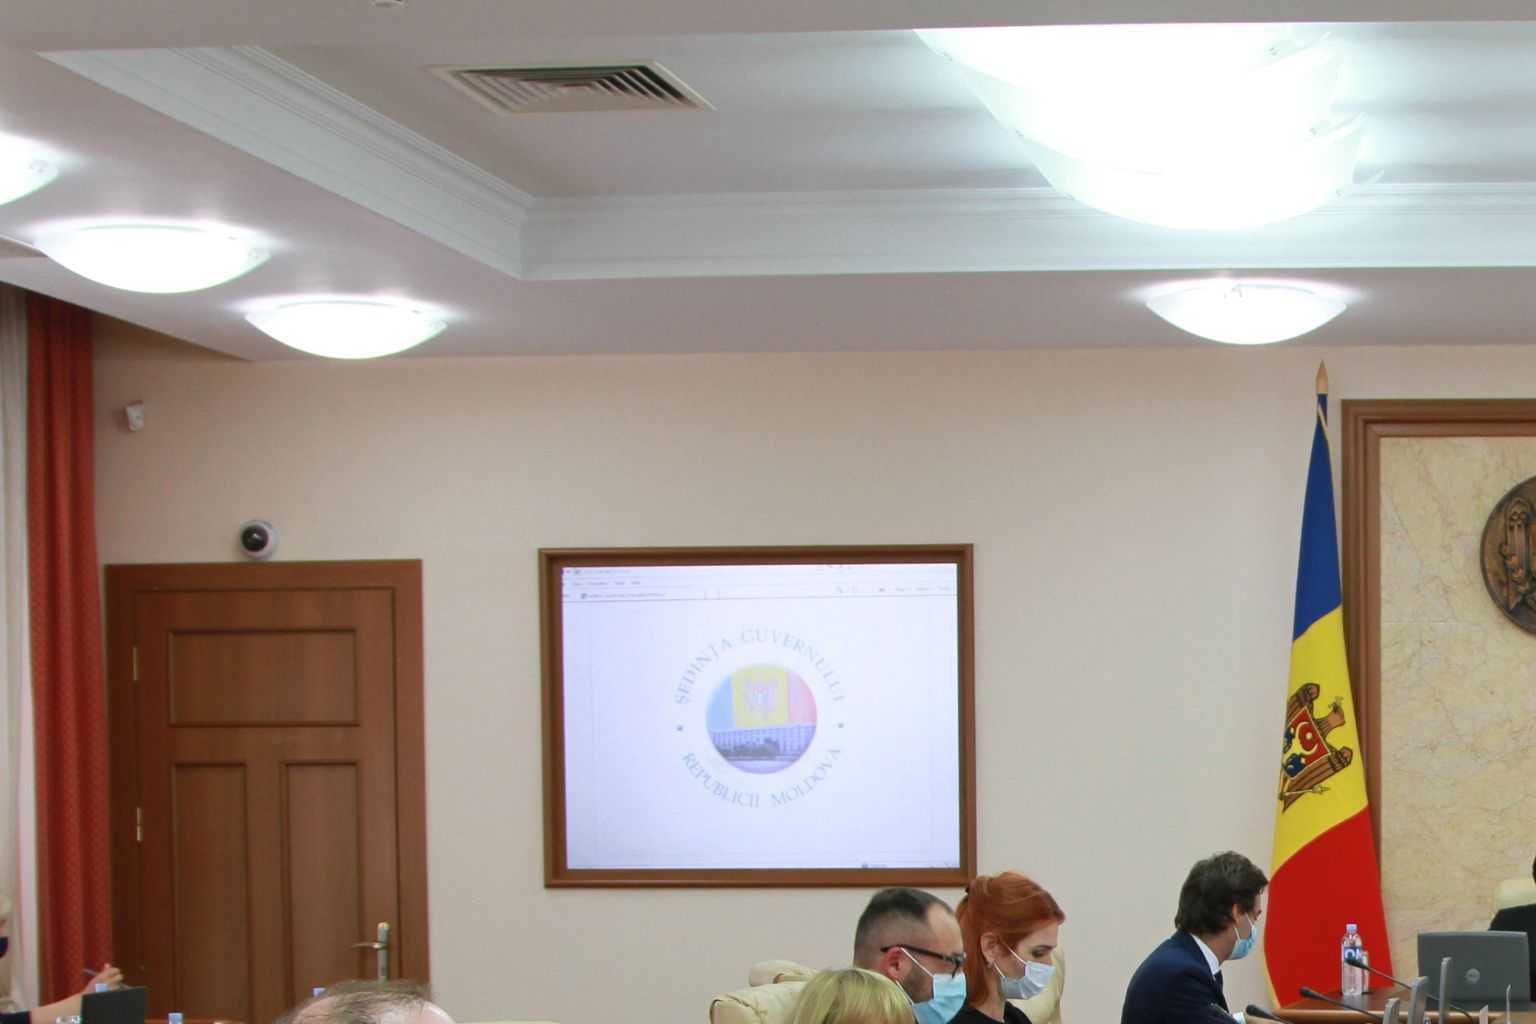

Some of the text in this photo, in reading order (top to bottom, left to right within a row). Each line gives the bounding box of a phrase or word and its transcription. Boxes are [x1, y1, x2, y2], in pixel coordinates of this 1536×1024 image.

[740, 628, 846, 703] GUVERNULUI
[681, 747, 842, 808] REPUBLICII MOLDOVA
